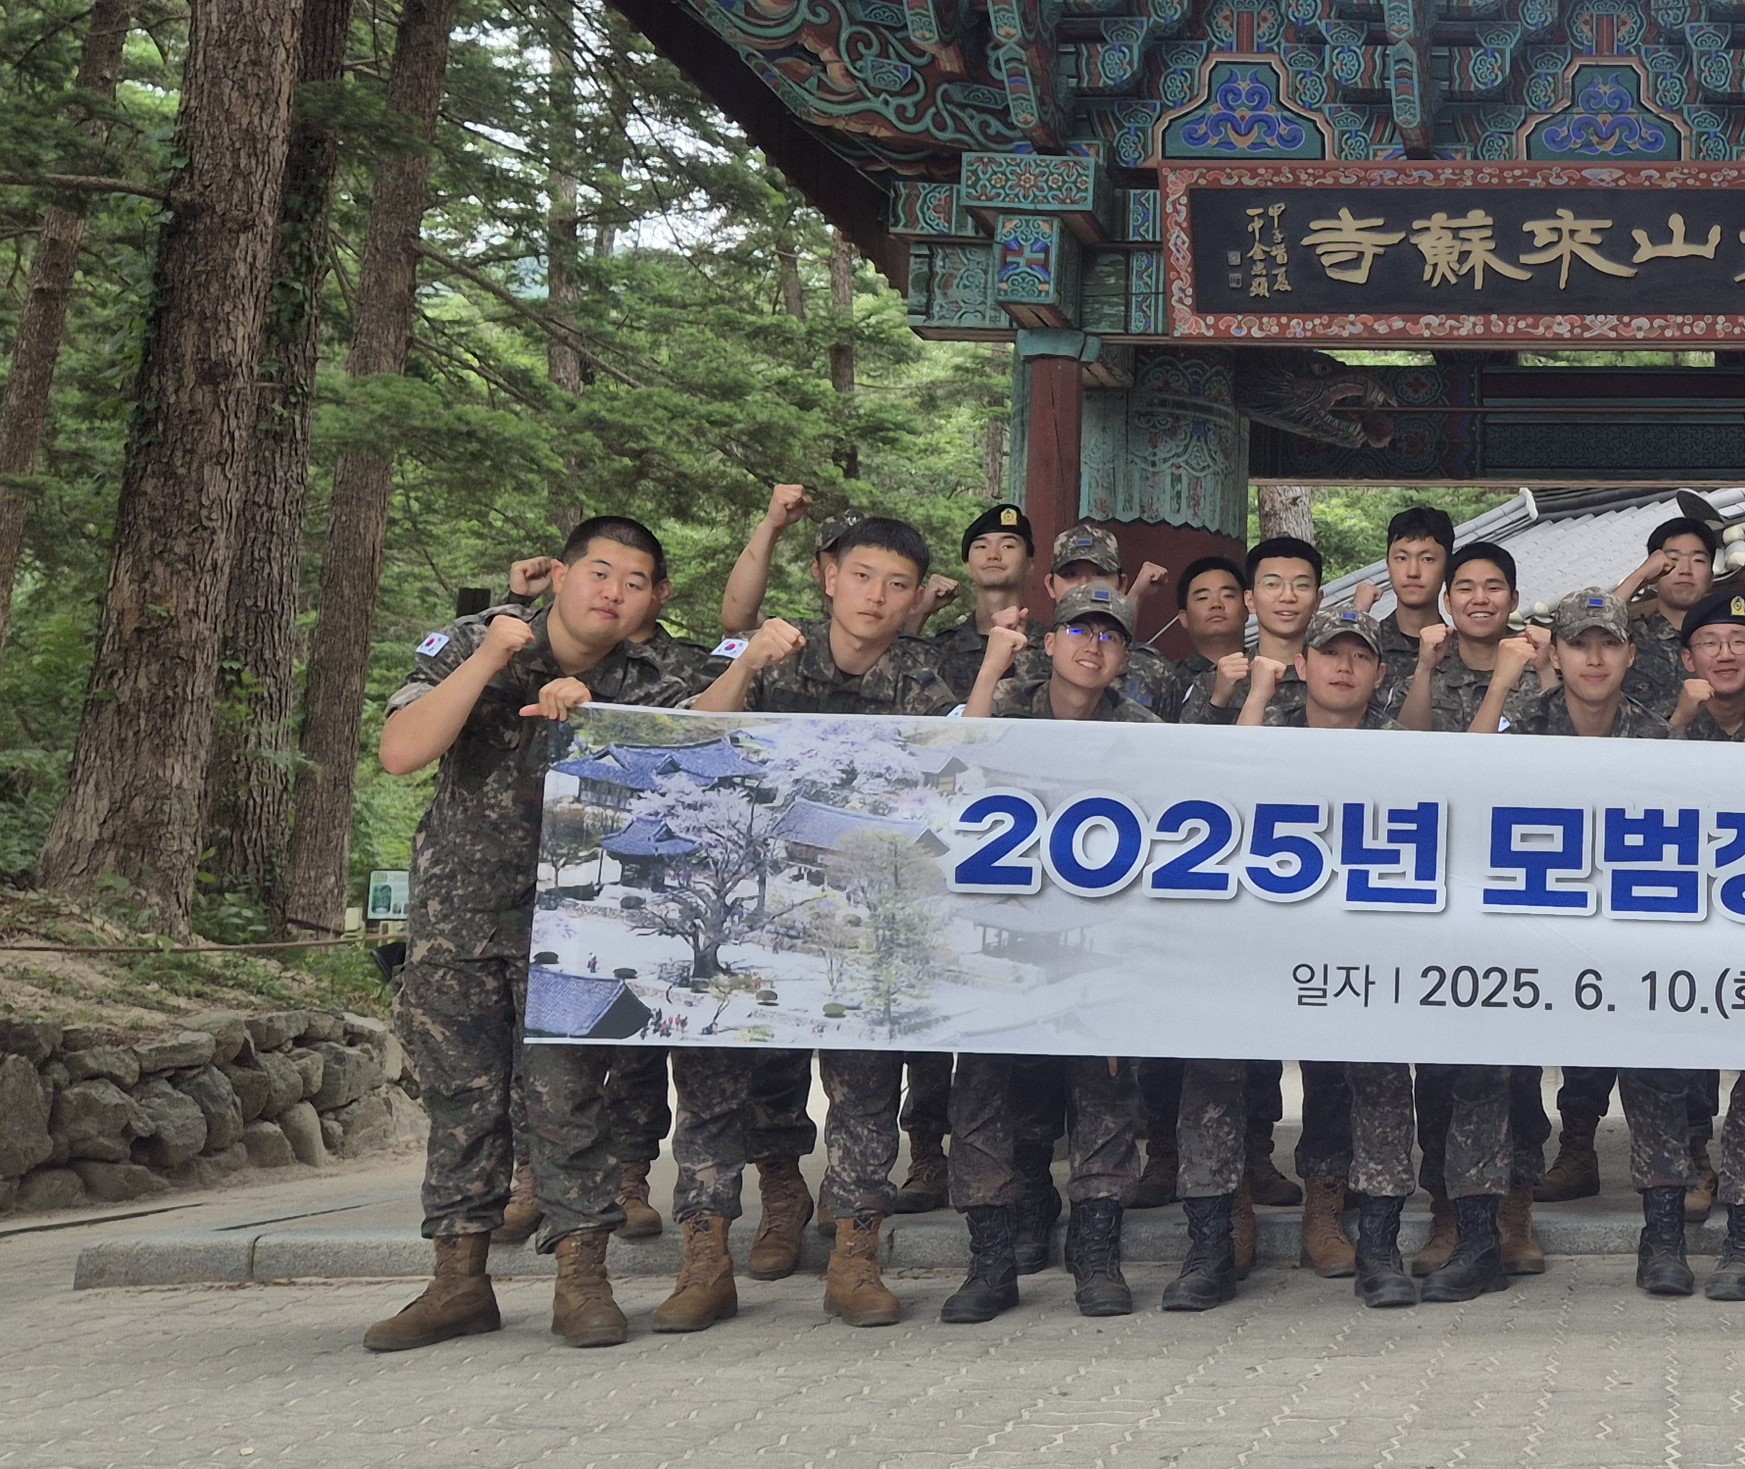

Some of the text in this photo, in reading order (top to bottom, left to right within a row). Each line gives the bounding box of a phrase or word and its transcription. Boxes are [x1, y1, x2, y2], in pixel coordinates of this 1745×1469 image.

[952, 793, 1440, 907] 2025년
[1291, 962, 1377, 1009] 일자
[1418, 964, 1554, 1011] 2025.
[1573, 967, 1617, 1013] 6.
